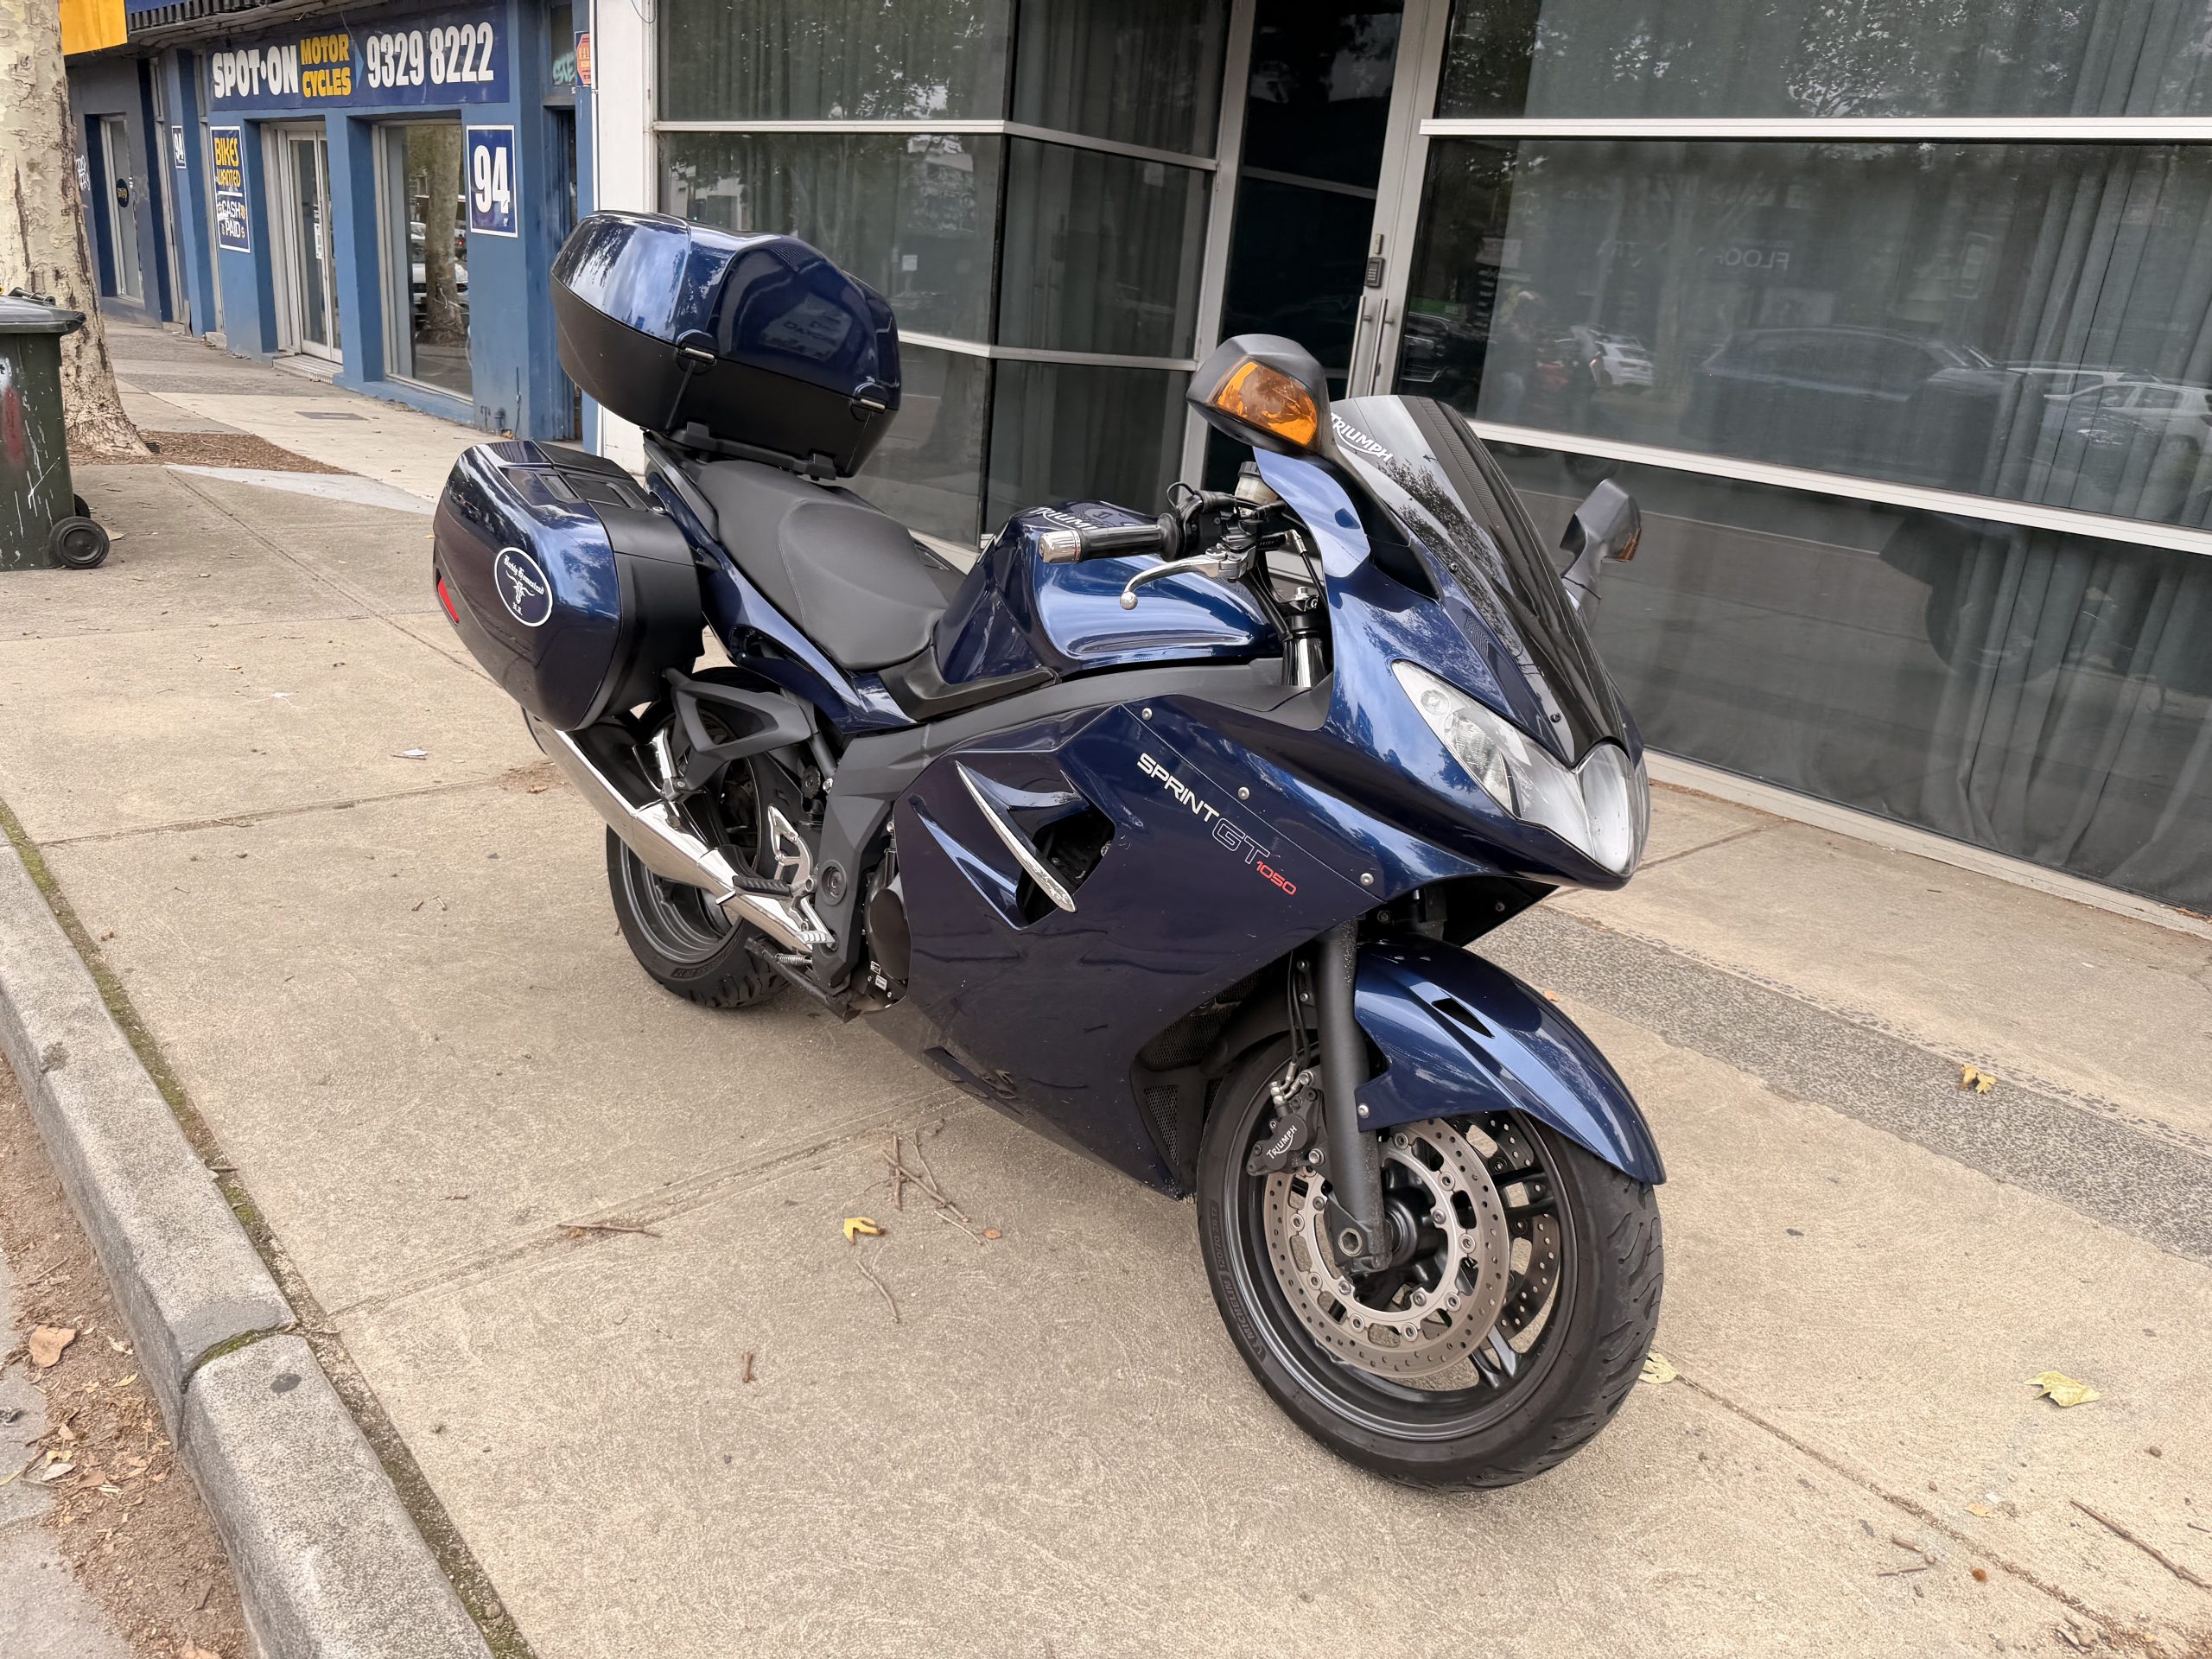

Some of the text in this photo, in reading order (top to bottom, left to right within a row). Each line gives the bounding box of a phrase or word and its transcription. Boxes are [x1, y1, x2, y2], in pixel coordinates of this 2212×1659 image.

[301, 34, 348, 65] MOTOR
[366, 22, 494, 88] 9329 8222
[302, 67, 352, 98] CYCLES
[174, 133, 183, 160] 94
[214, 137, 239, 166] BIKES
[216, 168, 241, 188] WANTED
[474, 145, 510, 213] 94
[1331, 412, 1394, 462] TRIUMPH
[1137, 753, 1297, 896] SPRINT GT 1050
[1266, 1125, 1297, 1159] TRIUMPH
[1224, 1281, 1255, 1340] MICHELIN
